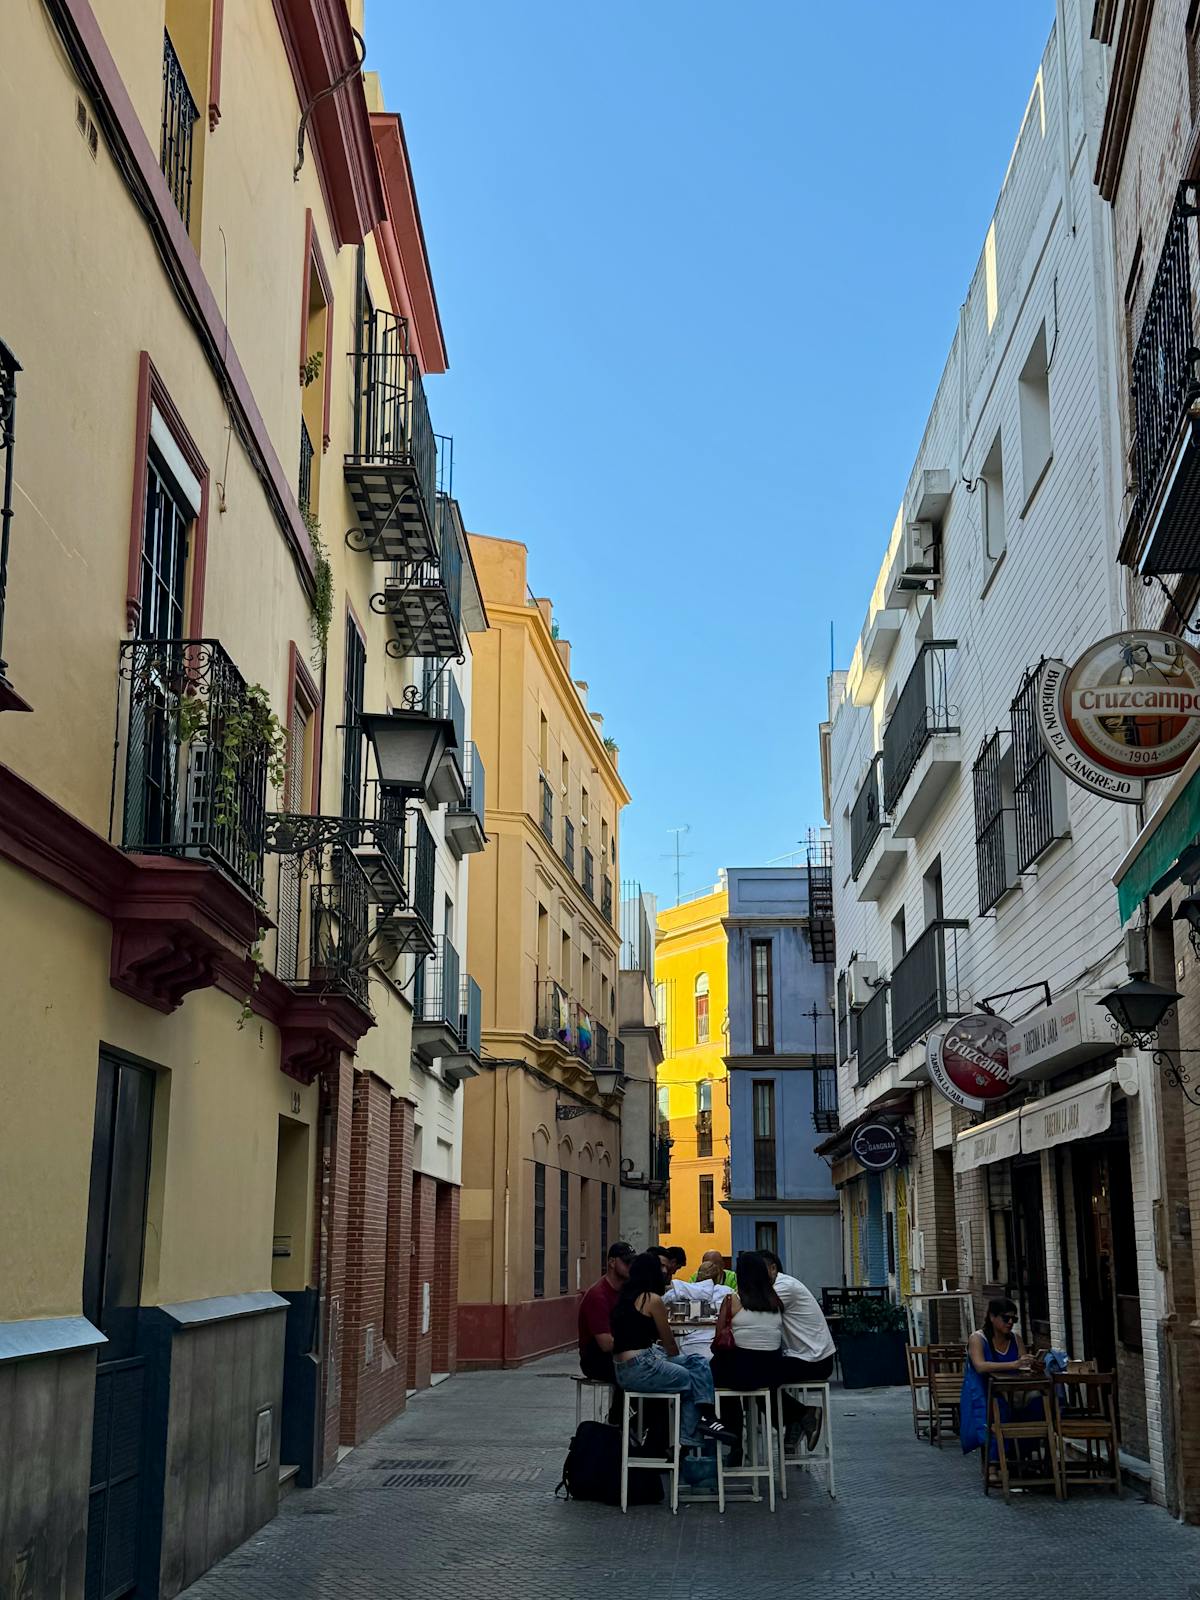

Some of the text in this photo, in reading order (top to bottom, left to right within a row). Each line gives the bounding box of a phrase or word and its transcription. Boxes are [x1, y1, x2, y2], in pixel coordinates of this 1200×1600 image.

[1043, 670, 1131, 794] BODEGON EL CANGREJO
[1128, 751, 1158, 763] 1904
[1023, 1026, 1040, 1056] TABERNA
[1040, 1023, 1047, 1049] LA
[1047, 1017, 1058, 1045] JARA
[930, 1053, 964, 1105] TABERNA LA JARA
